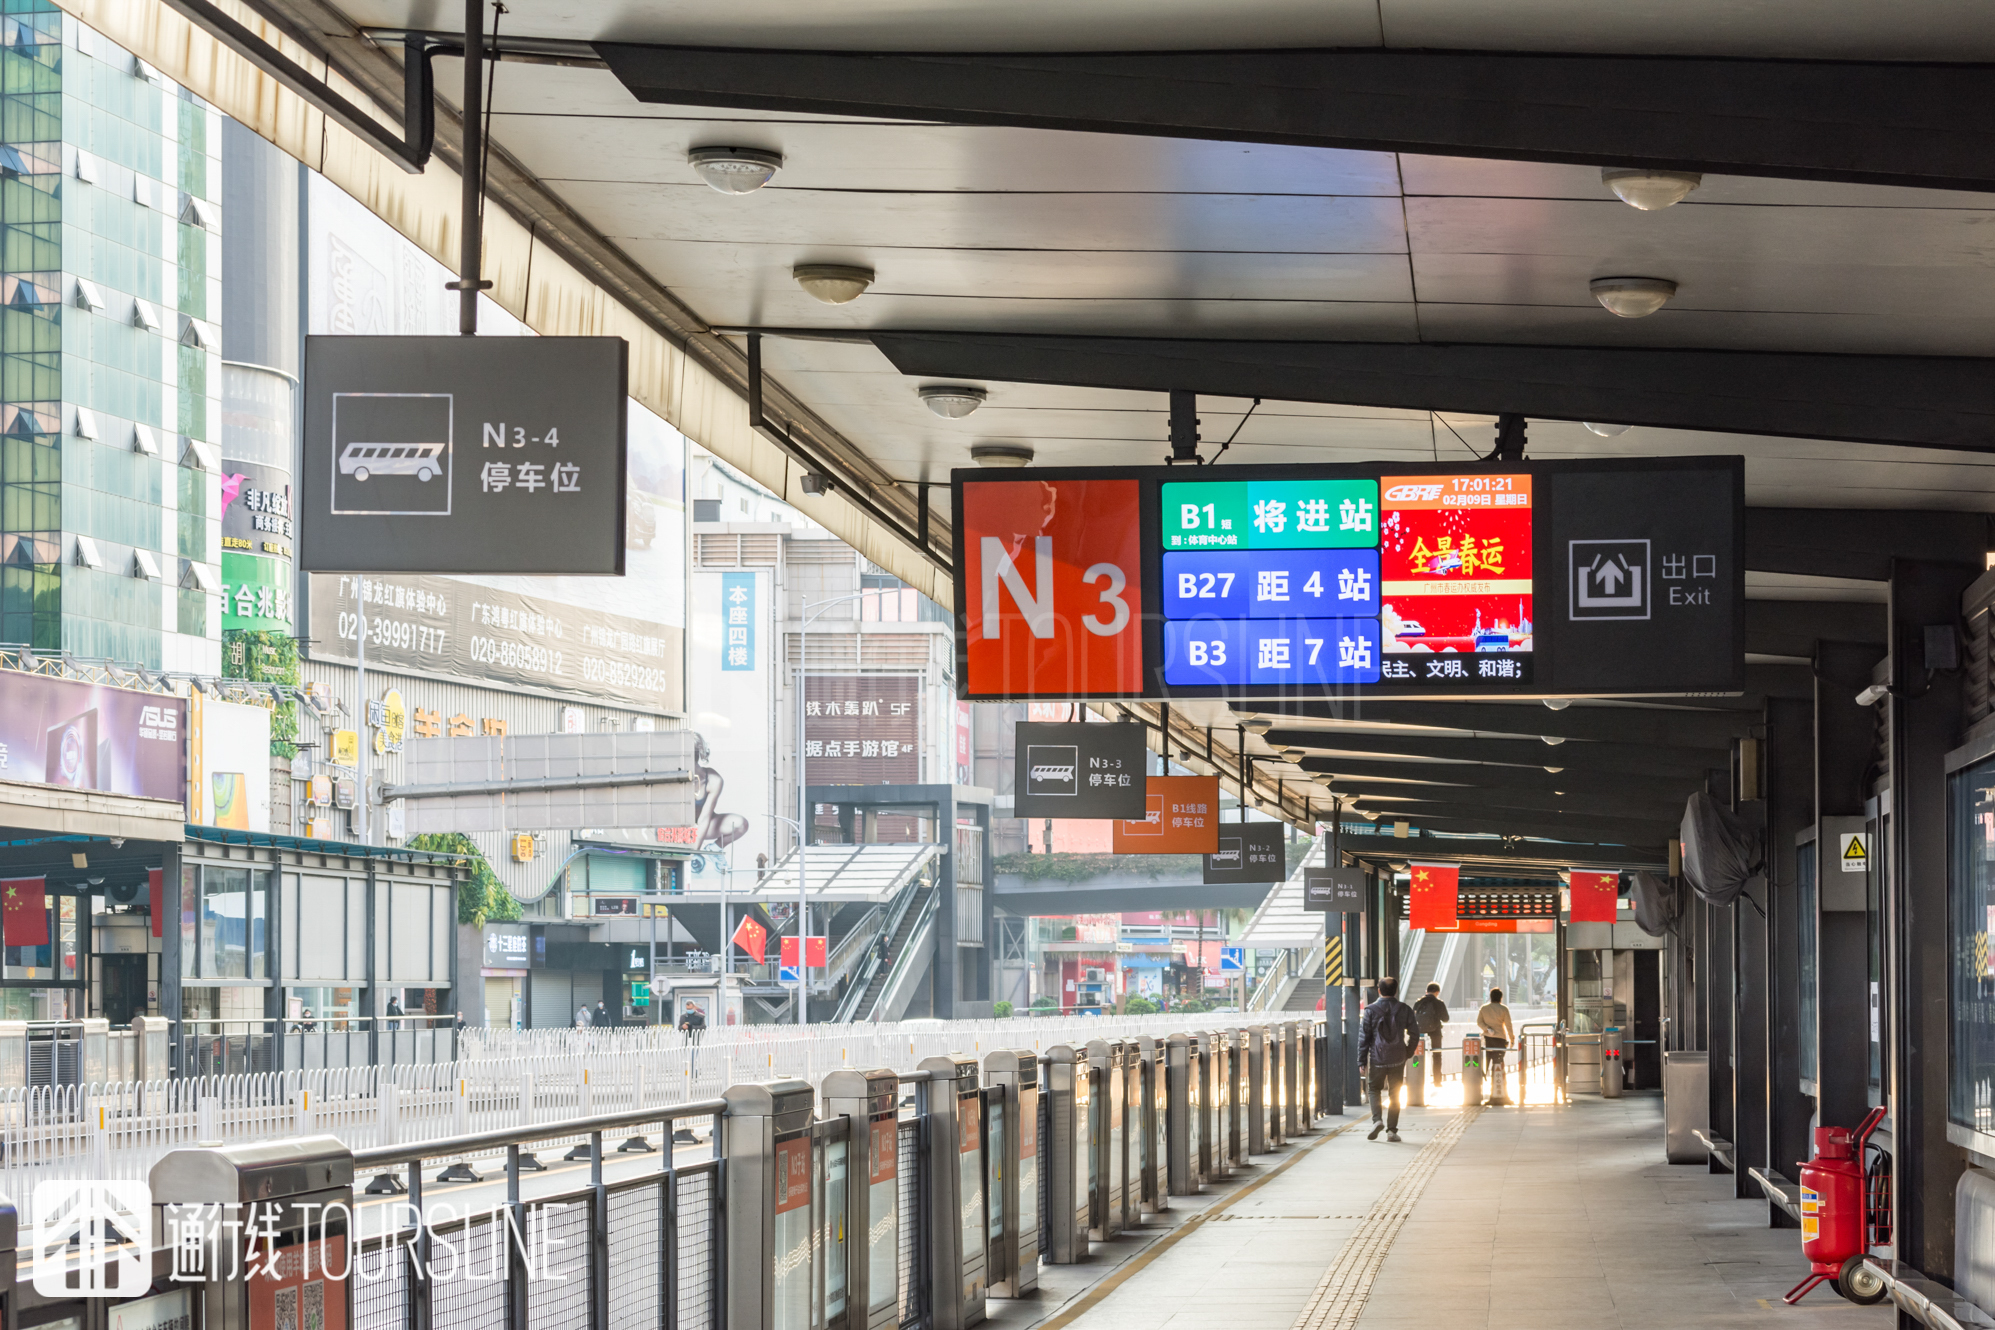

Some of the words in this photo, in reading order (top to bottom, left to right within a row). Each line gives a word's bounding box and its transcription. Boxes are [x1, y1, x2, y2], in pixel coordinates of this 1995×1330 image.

[480, 461, 581, 494] 停车位
[1451, 477, 1513, 492] 17:01:21
[1442, 494, 1492, 507] 02月09日
[1494, 493, 1528, 506] 星期日
[1408, 533, 1506, 577] 全景春运
[1662, 553, 1717, 580] 出口
[1178, 573, 1236, 599] B27
[1669, 586, 1711, 605] Exit
[728, 585, 749, 667] 本座四楼
[470, 635, 563, 675] 020-86058912
[1189, 640, 1228, 667] B3
[139, 705, 178, 729] ASUS
[805, 740, 900, 758] 据点手游馆
[901, 744, 914, 753] 4F
[1089, 773, 1131, 787] 停车位
[1172, 803, 1208, 814] B1线路
[1171, 817, 1205, 828] 停车位
[1248, 854, 1277, 863] 停车位
[1337, 890, 1358, 898] 停车位
